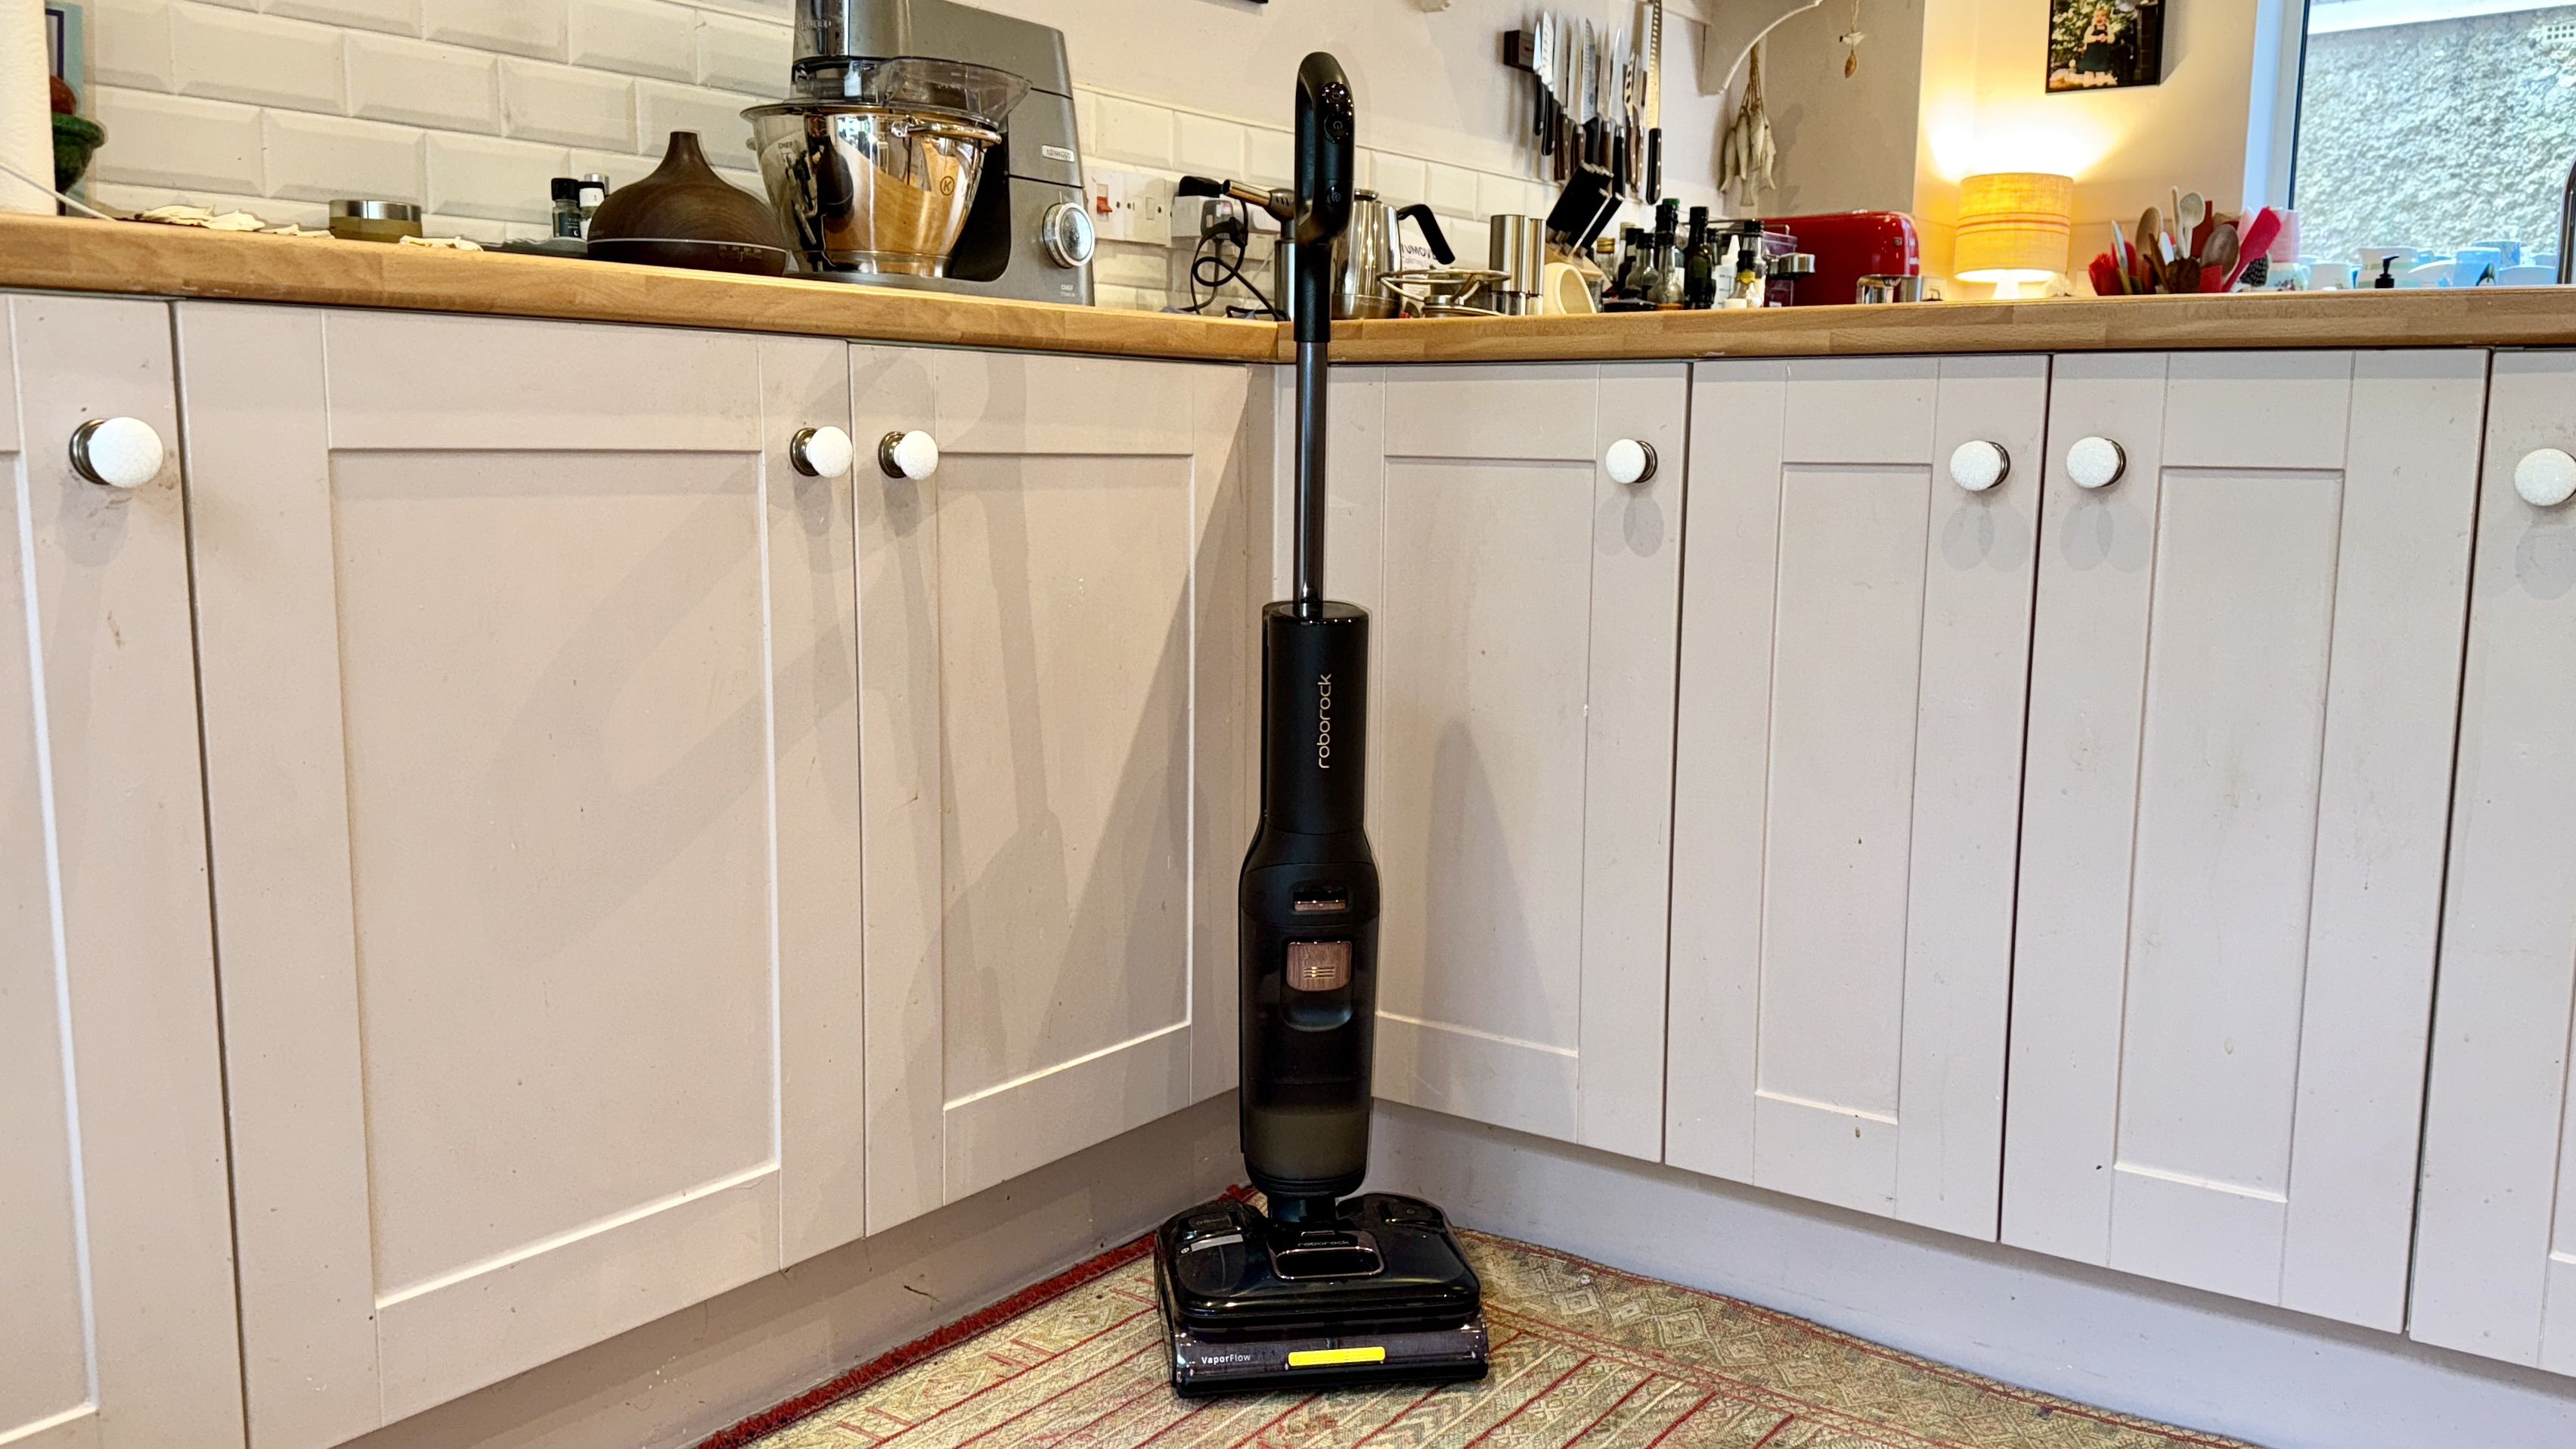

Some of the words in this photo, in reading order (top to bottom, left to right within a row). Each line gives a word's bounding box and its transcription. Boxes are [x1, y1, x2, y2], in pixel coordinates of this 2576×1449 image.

[1046, 148, 1071, 159] KENWOOD
[1316, 673, 1331, 768] roborock
[1201, 1354, 1251, 1365] VaporFlow
